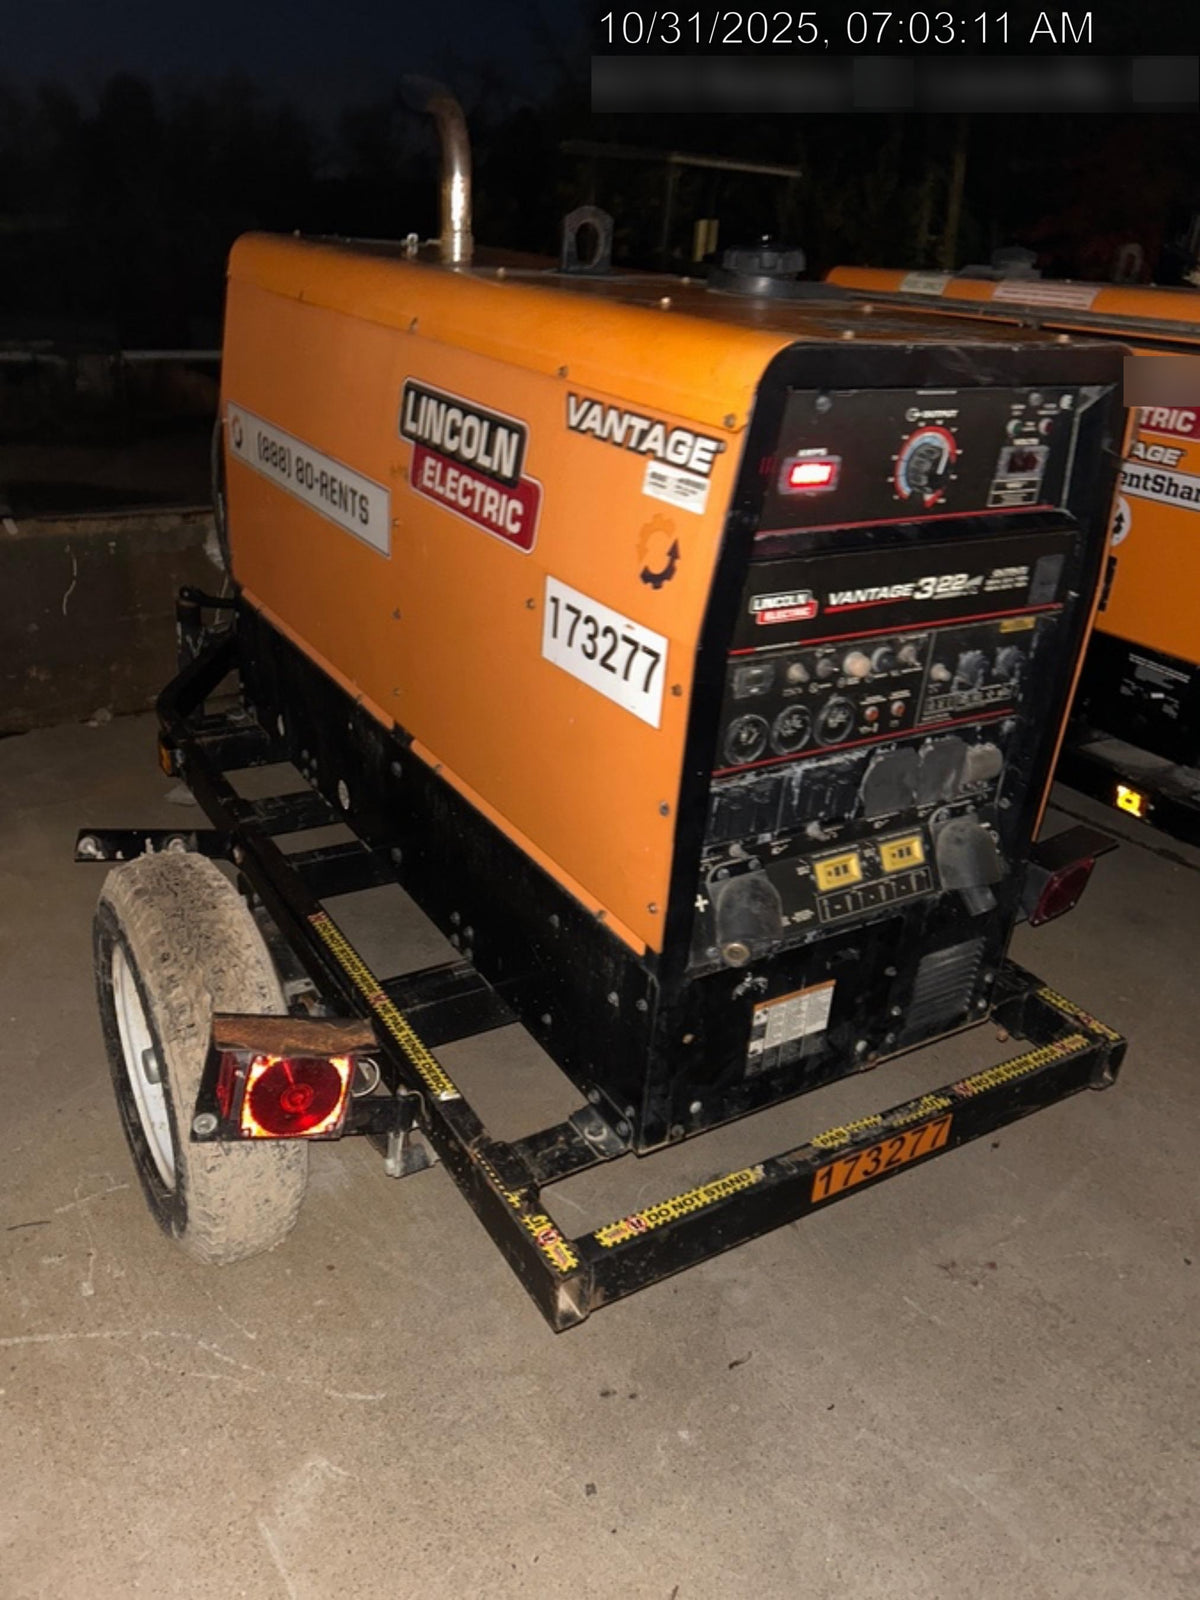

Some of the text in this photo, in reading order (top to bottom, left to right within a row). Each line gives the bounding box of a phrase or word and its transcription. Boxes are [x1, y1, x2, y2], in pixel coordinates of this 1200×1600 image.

[404, 390, 520, 479] LINCOLN
[567, 394, 718, 476] VANTAGE
[1139, 407, 1197, 434] TRIC
[256, 430, 370, 526] (888) 80-RENTS
[422, 455, 524, 535] ELECTRIC
[828, 582, 916, 606] VANTAGE
[549, 595, 661, 694] 173277
[818, 1118, 949, 1196] 173277
[647, 1172, 751, 1223] DO NOT STAND
